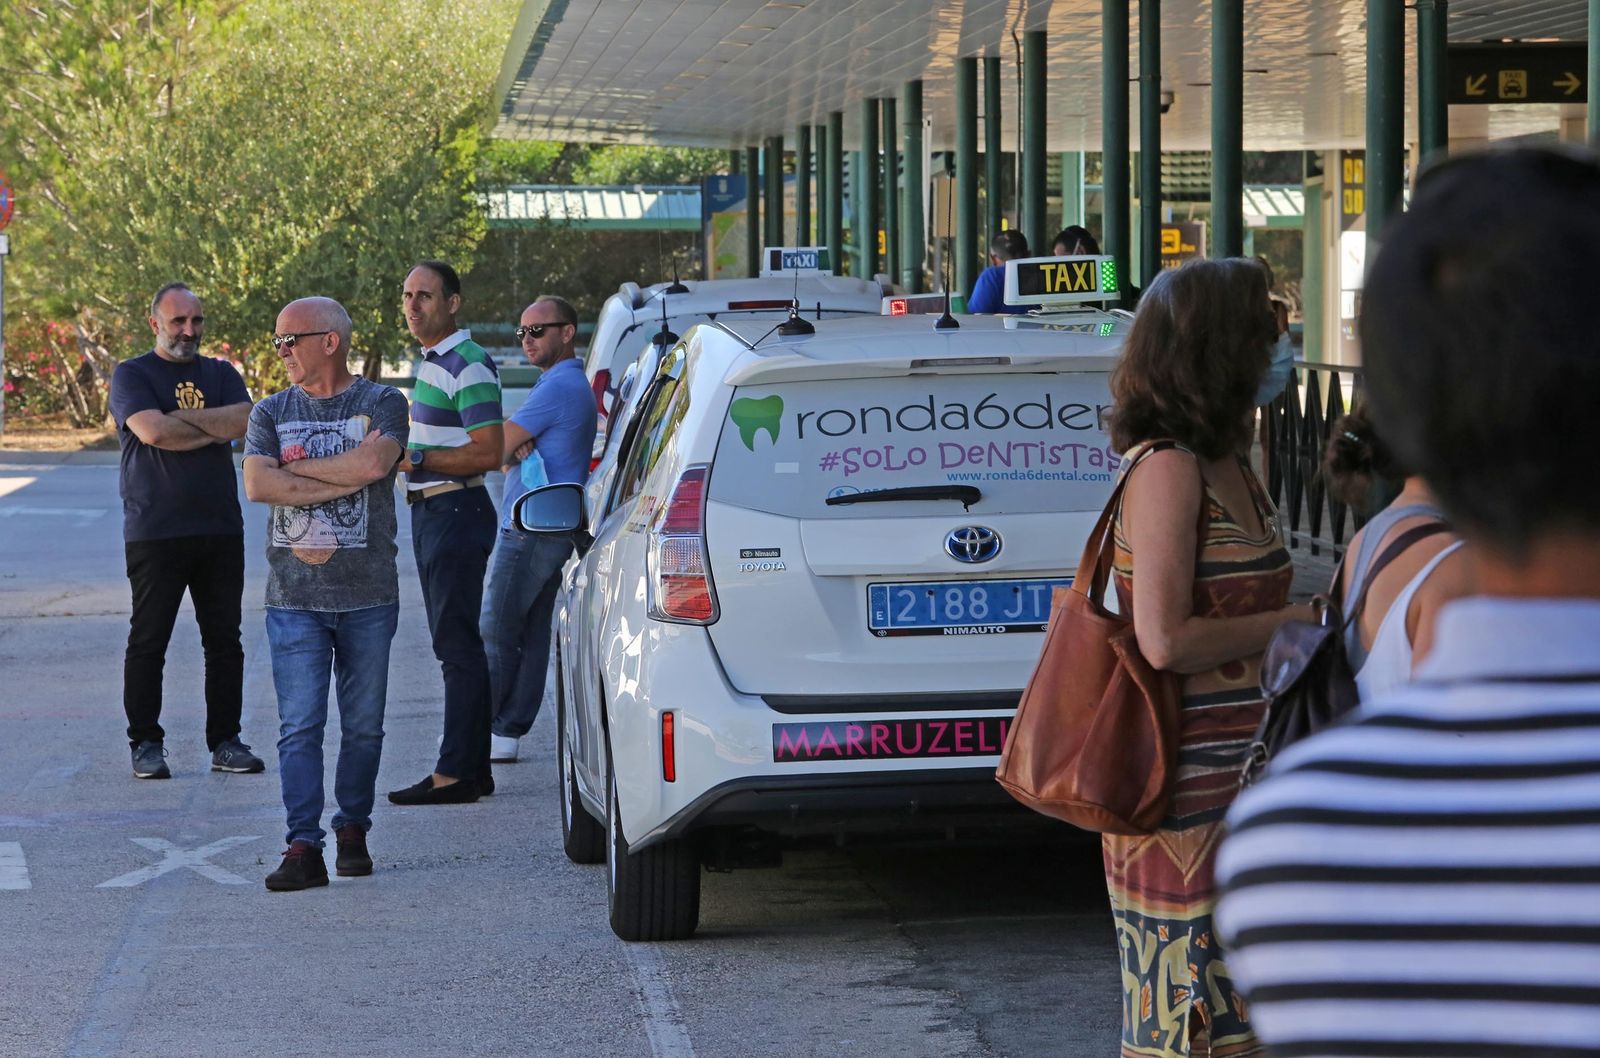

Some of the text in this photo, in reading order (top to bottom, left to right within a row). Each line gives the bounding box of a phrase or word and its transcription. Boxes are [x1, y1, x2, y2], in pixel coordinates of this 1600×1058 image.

[785, 252, 816, 267] TAXI
[1040, 262, 1096, 292] TAXI
[947, 469, 1111, 482] www.ronda6dental.com
[739, 561, 787, 572] TOYOTA
[876, 584, 1070, 622] E 2188 JT
[943, 625, 1006, 635] NIMAUTO
